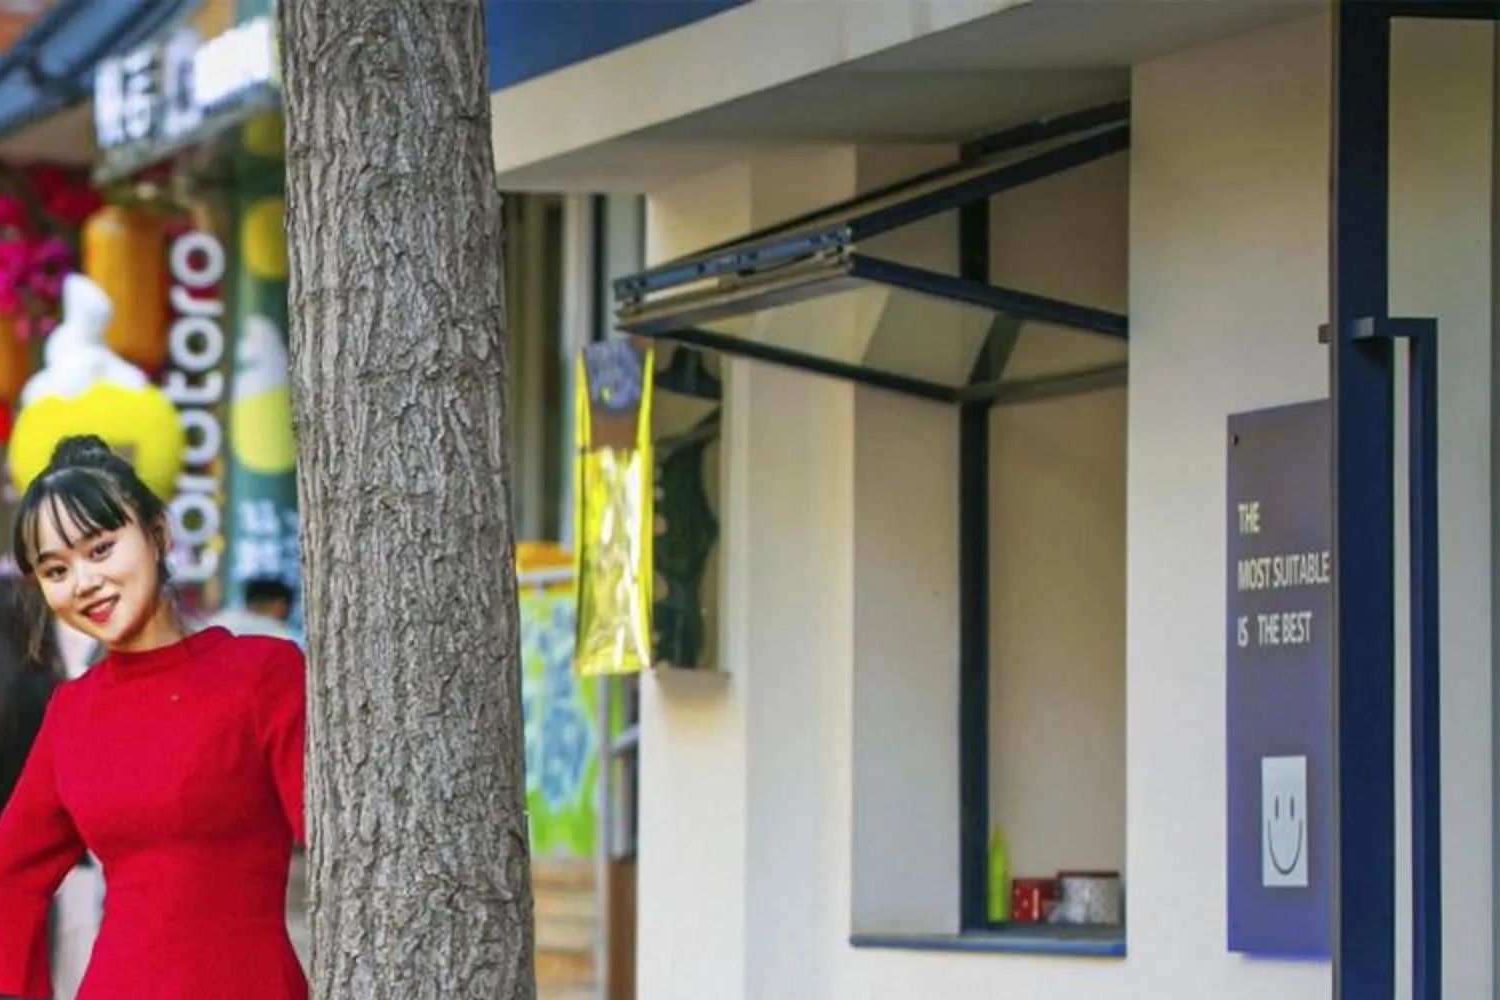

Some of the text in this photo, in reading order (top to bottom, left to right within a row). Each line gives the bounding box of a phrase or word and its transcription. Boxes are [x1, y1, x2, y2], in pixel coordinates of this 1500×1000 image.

[1238, 502, 1260, 534] THE
[1238, 551, 1331, 591] MOST SUITABLE
[1237, 611, 1312, 648] IS THE BEST
